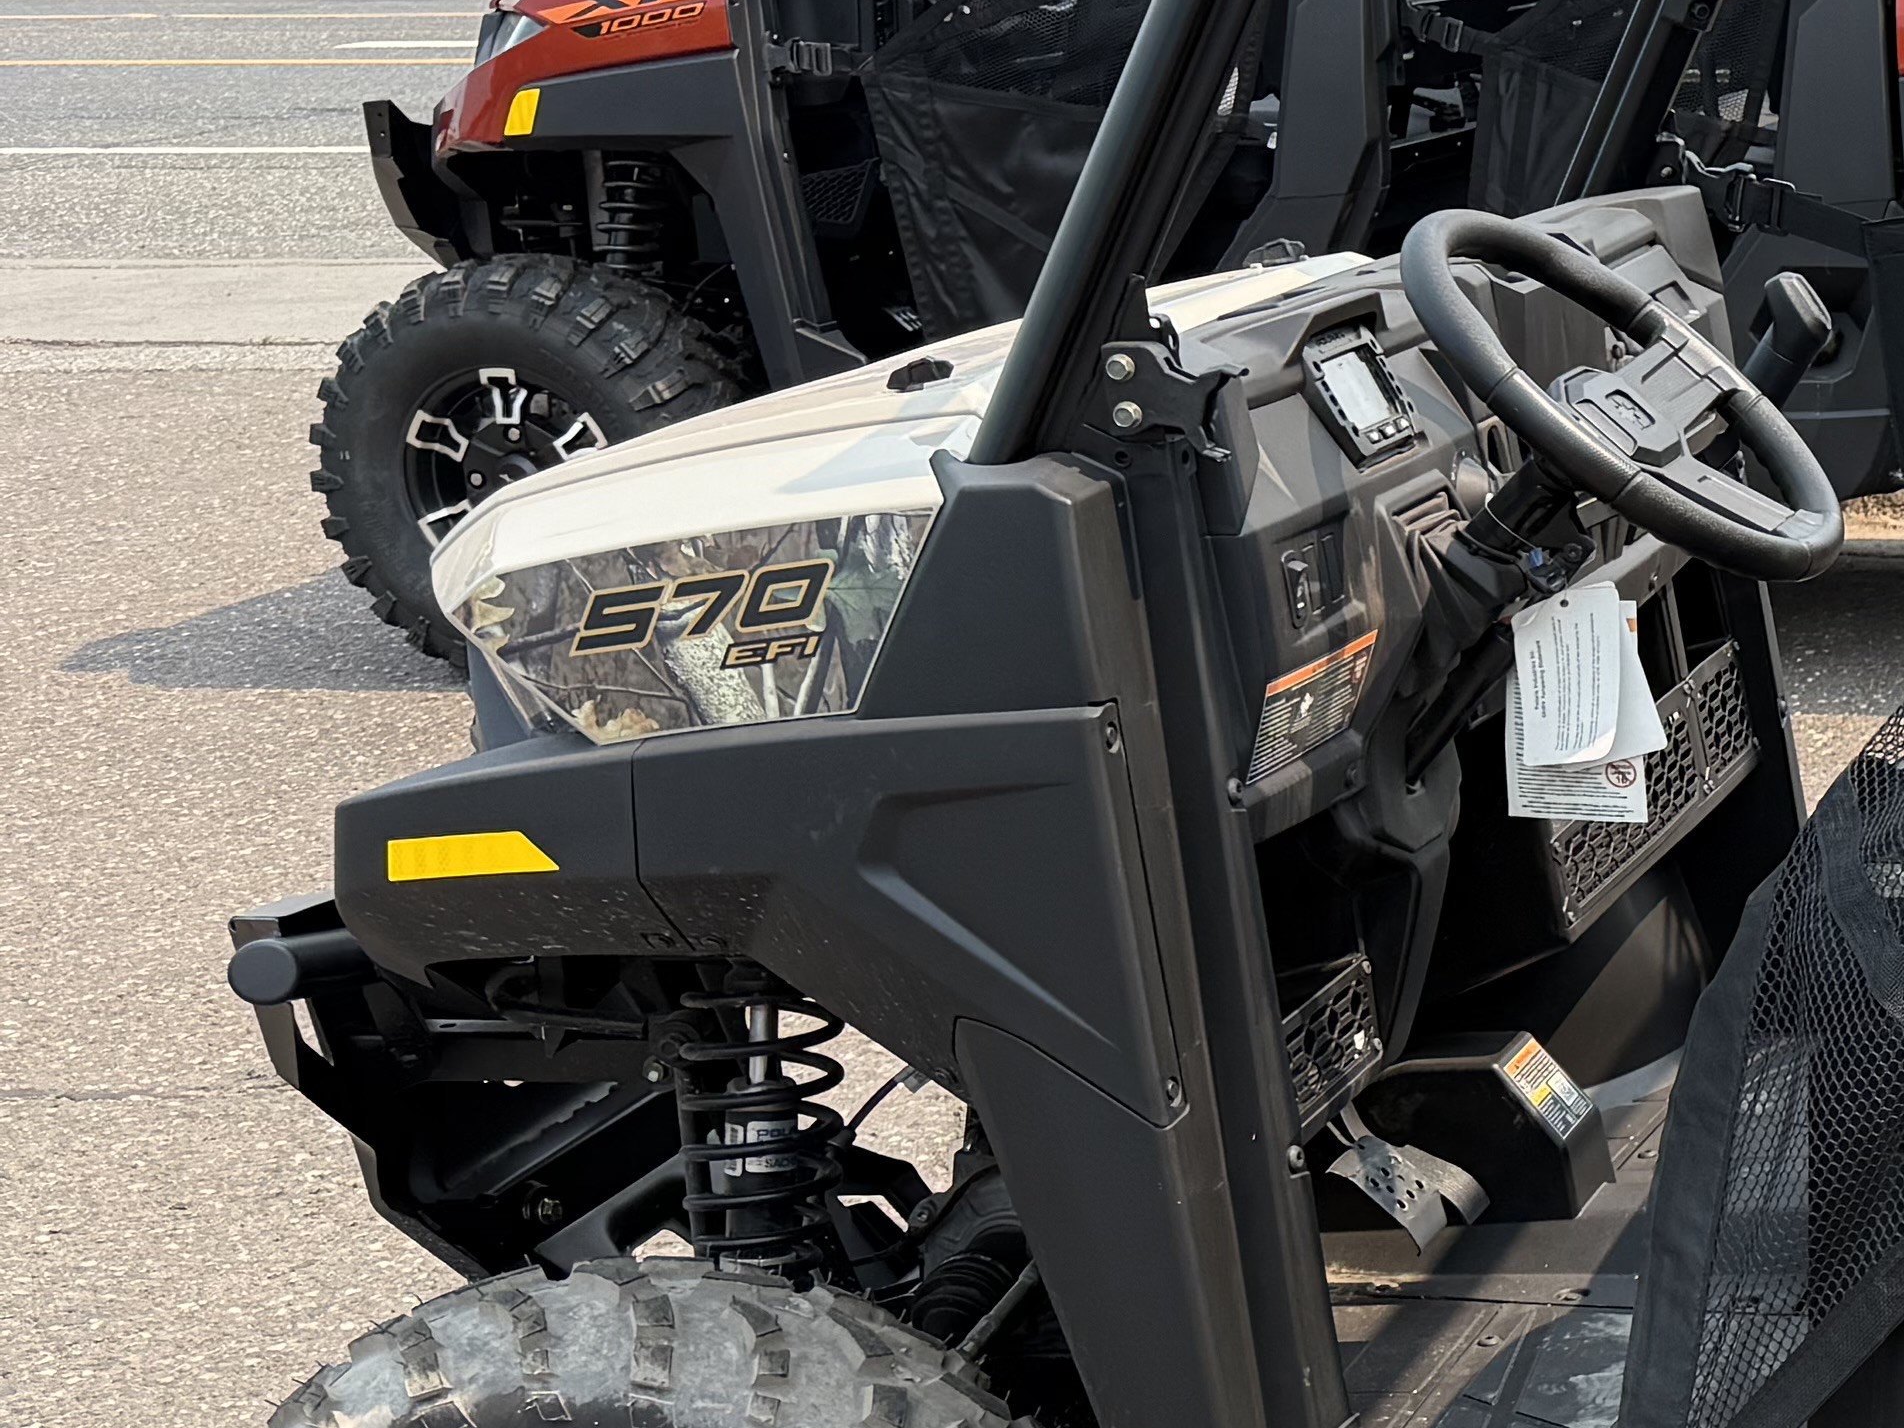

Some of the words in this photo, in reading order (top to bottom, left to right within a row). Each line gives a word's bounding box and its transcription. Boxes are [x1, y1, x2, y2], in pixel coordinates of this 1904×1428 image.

[600, 1, 705, 35] 1000
[568, 558, 834, 658] 570
[722, 633, 821, 669] EFI
